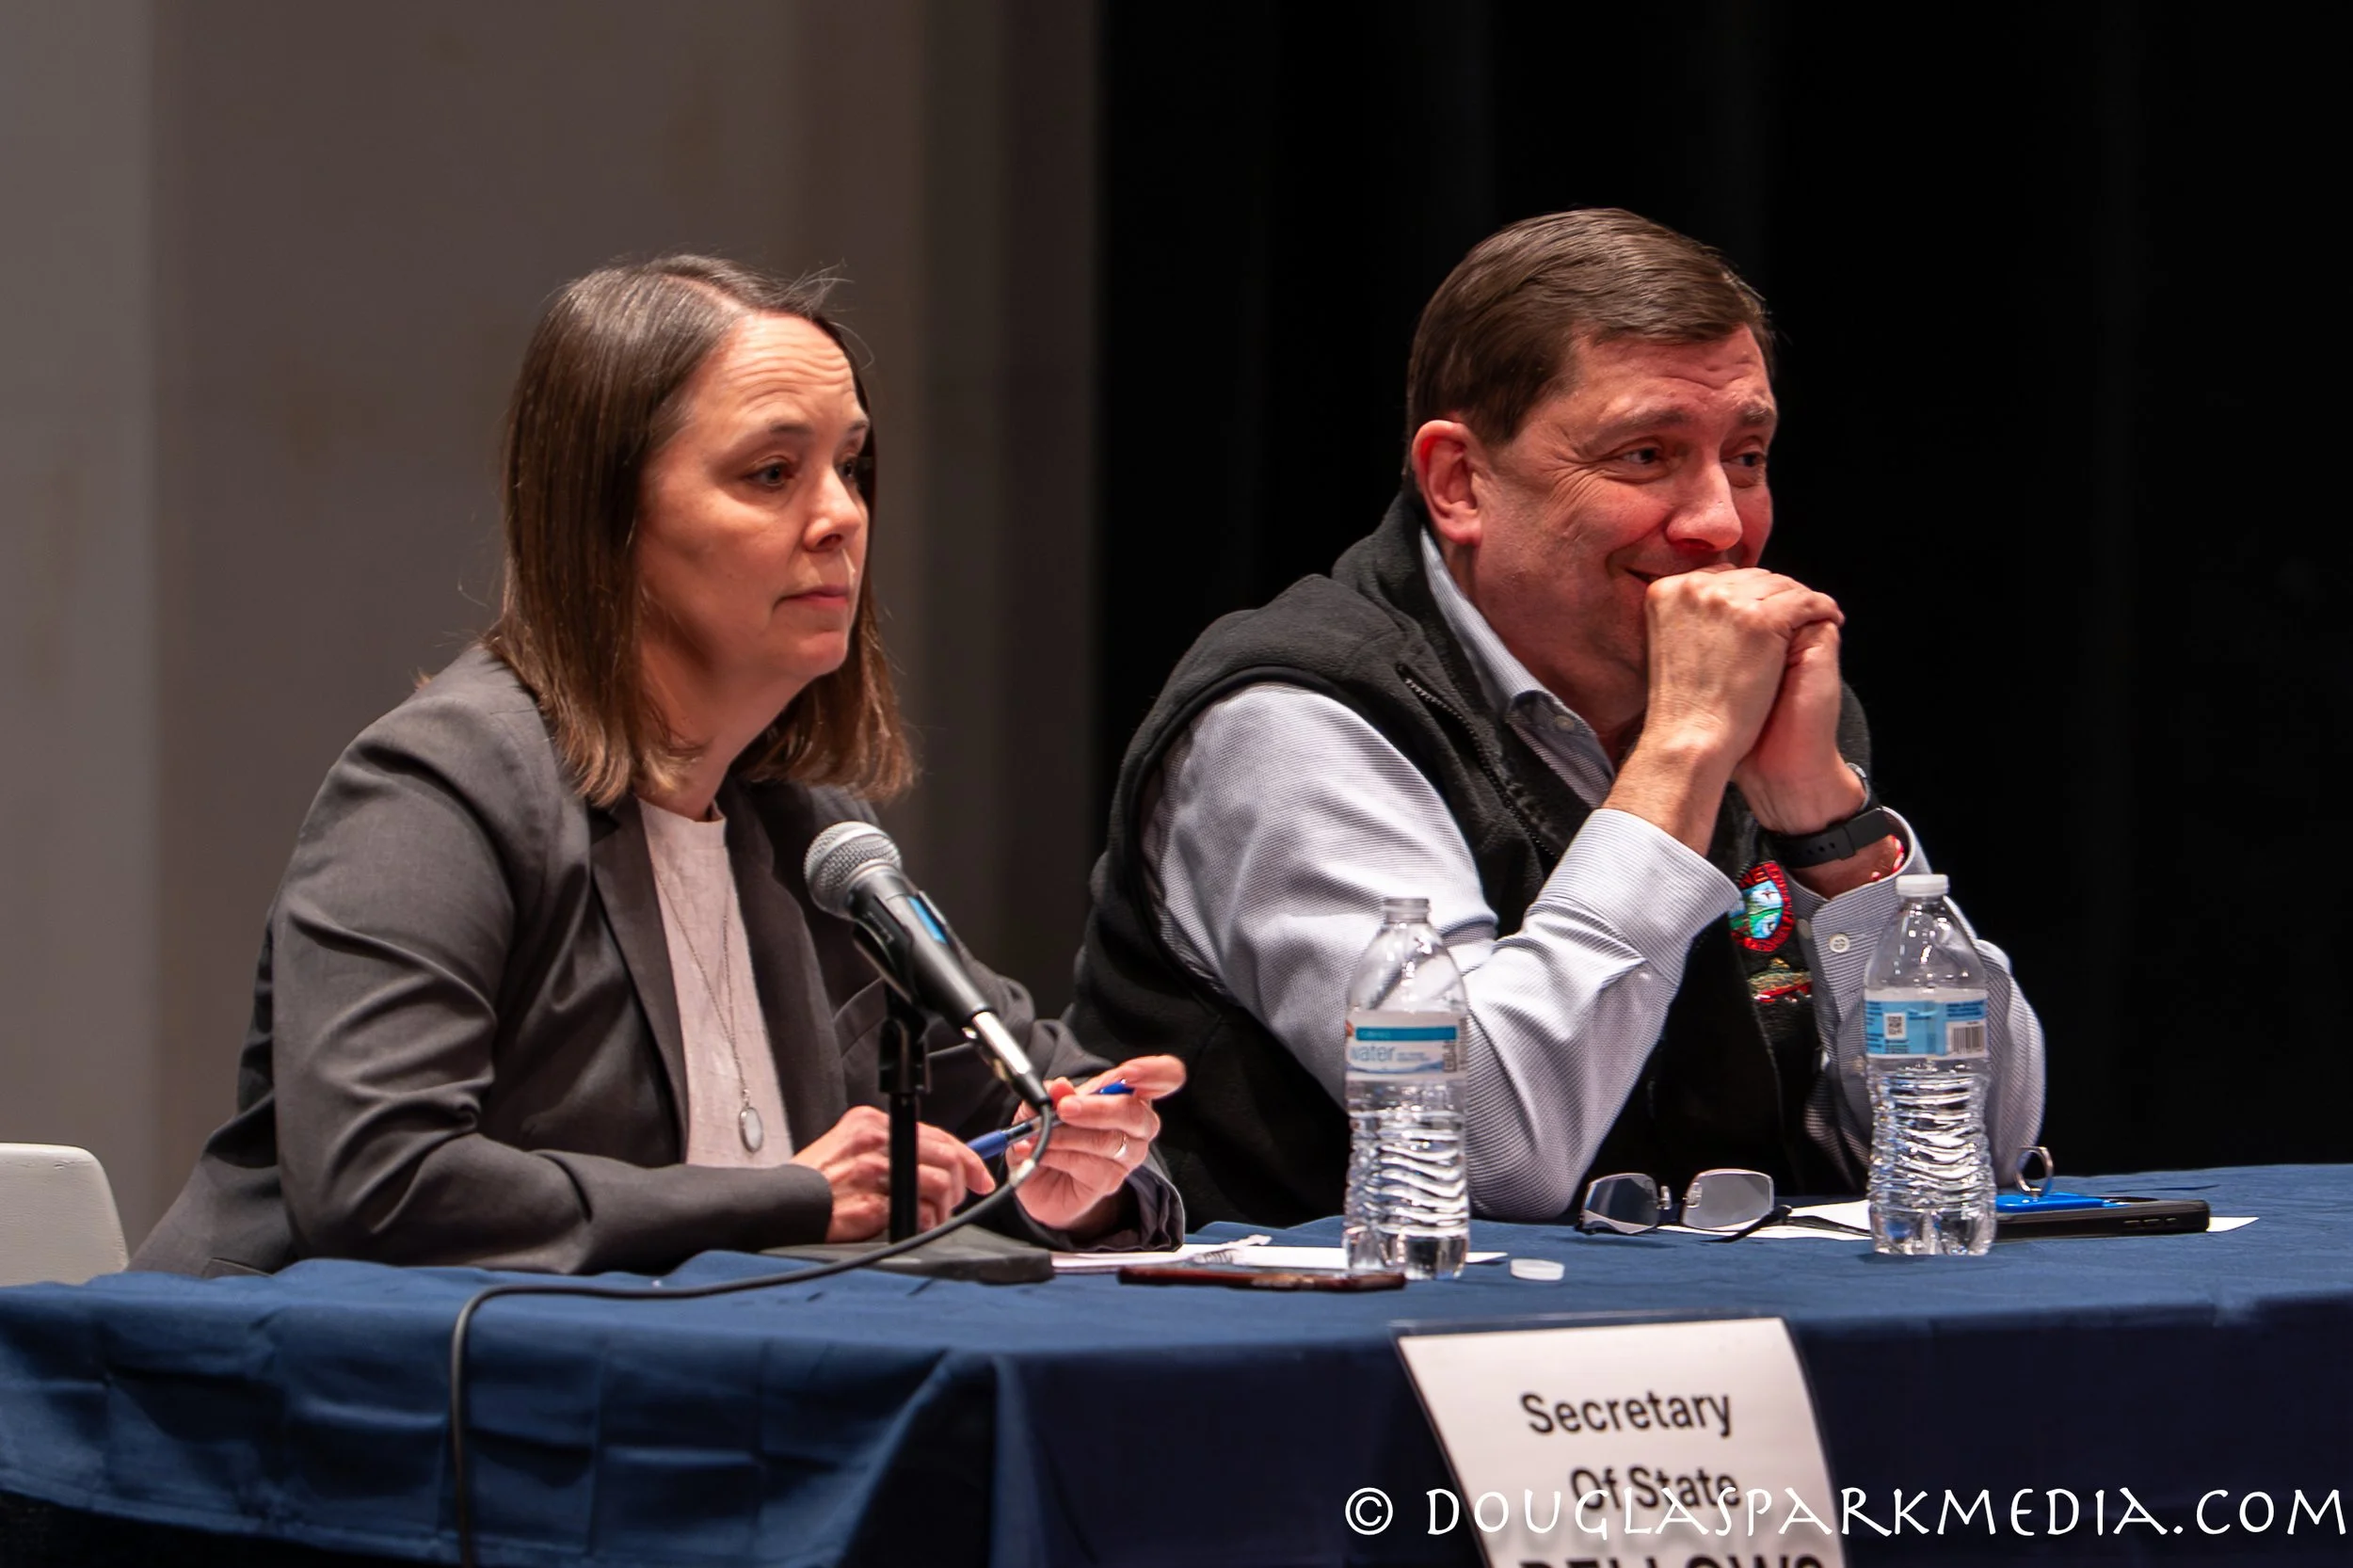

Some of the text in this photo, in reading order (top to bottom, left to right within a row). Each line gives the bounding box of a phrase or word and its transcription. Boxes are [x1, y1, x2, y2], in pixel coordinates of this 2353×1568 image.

[1520, 1390, 1732, 1438] Secretary
[1570, 1464, 1741, 1511] Of State
